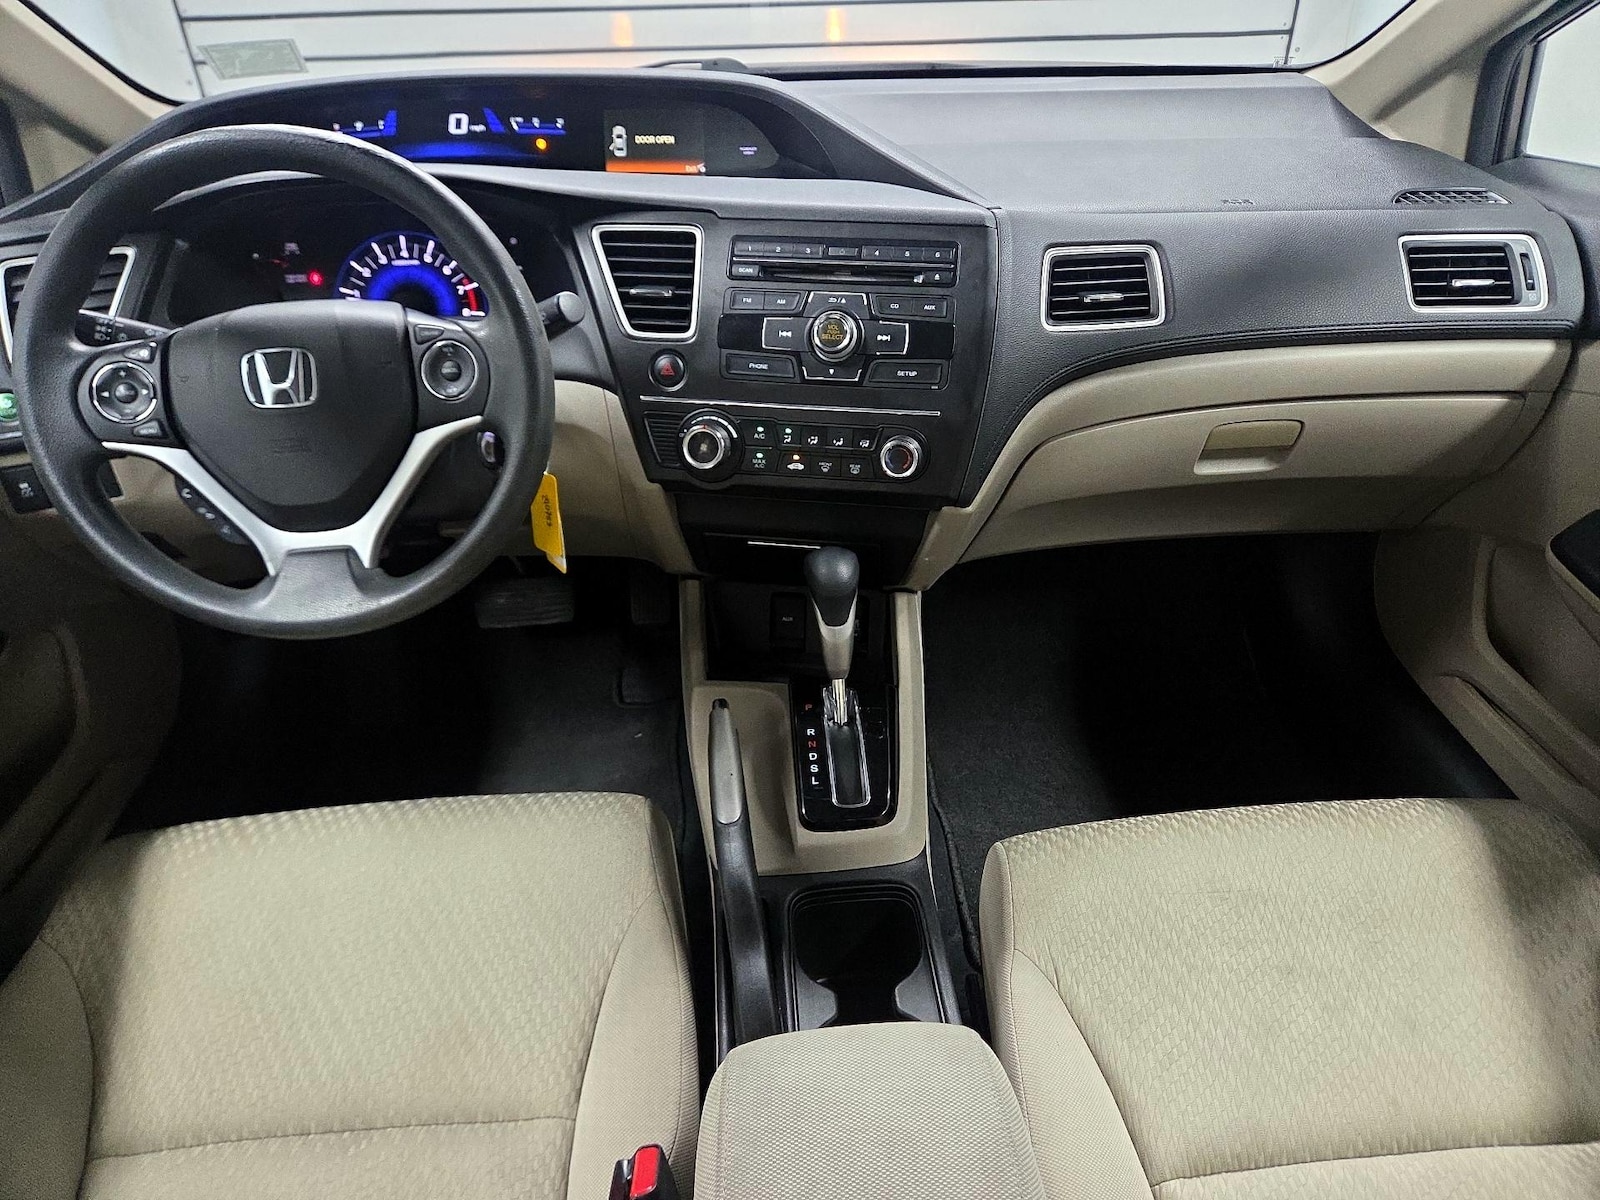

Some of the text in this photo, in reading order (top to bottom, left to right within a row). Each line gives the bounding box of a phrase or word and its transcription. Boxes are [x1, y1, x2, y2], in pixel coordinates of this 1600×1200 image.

[448, 113, 469, 135] 0
[634, 135, 675, 144] DOOR OPEN
[748, 362, 769, 370] PHONE
[806, 728, 816, 736] R
[808, 740, 817, 748] N
[808, 752, 818, 761] D
[810, 764, 819, 773] S
[811, 776, 820, 785] L
